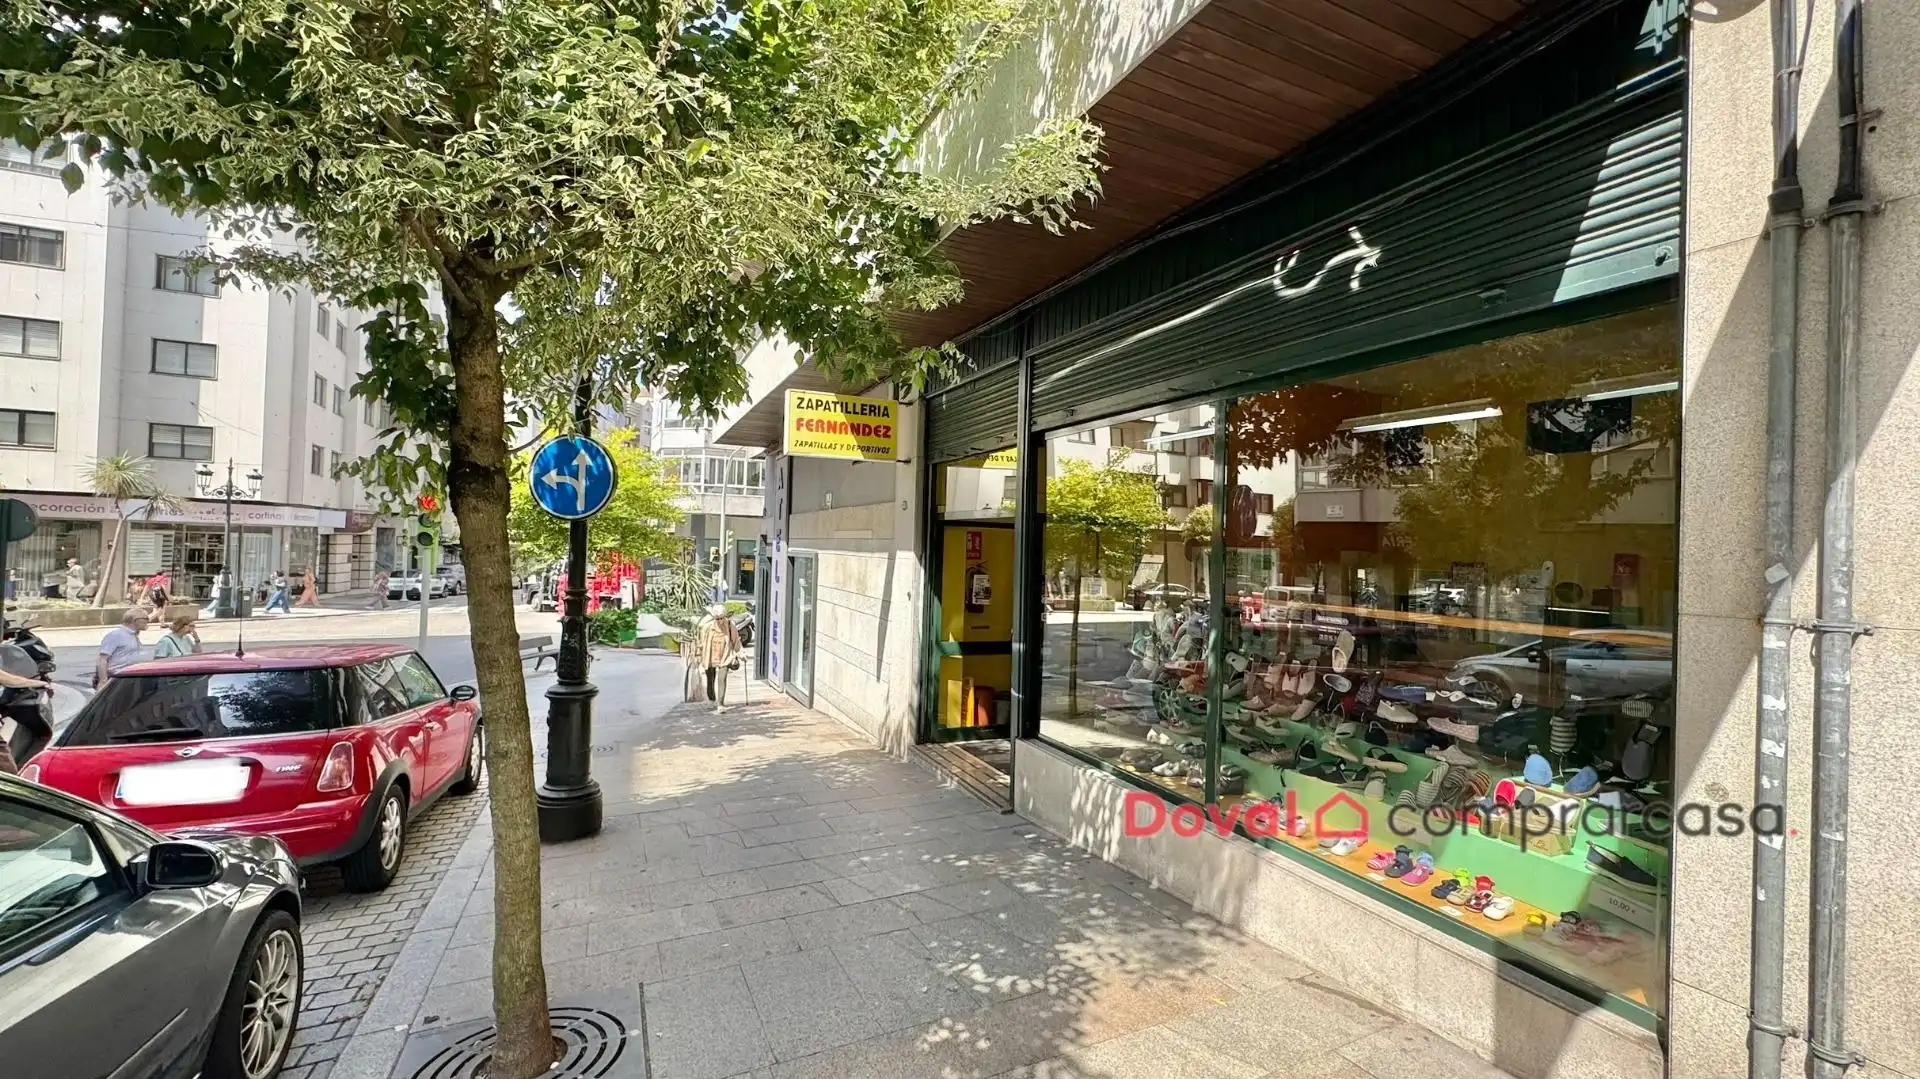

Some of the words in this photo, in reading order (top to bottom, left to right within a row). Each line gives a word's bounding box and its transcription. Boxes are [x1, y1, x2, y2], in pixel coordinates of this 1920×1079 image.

[796, 397, 890, 418] ZAPATILLERIA
[796, 417, 892, 439] FERNANDEZ
[794, 439, 837, 451] ZAPATILLAS
[839, 443, 845, 451] Y
[846, 443, 891, 455] DEPORTIVOS
[31, 502, 106, 514] ecoración
